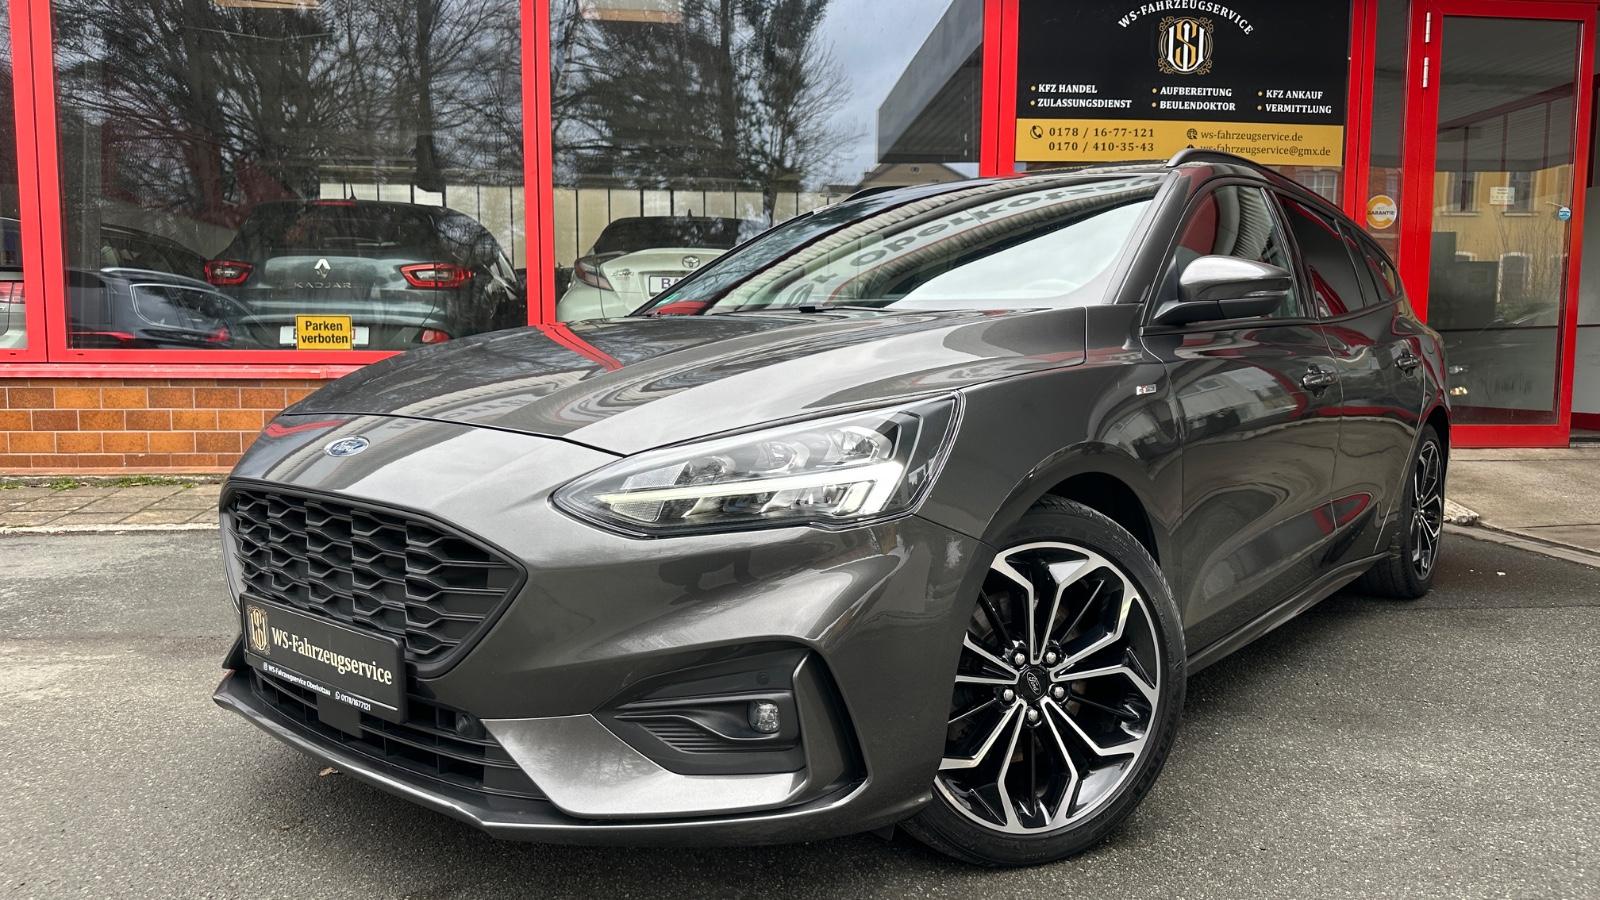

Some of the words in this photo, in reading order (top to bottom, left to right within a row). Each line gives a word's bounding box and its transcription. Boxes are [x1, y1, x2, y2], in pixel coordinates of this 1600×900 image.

[1118, 0, 1254, 35] WS-FAHRZEUGSERVICE
[1038, 84, 1057, 93] KFZ
[1058, 84, 1098, 94] HANDEL
[1160, 86, 1232, 97] AUFBEREITUNG
[1266, 89, 1284, 99] KFZ
[1285, 90, 1324, 100] ANKAUF
[1037, 98, 1132, 108] ZULASSUNGSDIENST
[1159, 100, 1236, 111] BEULENDOKTOR
[1265, 104, 1332, 114] VERMITTLUNG
[1048, 127, 1079, 137] 0178
[1094, 127, 1154, 138] 16-77-121
[1200, 130, 1303, 142] ws-fahrzeugservice.de
[1048, 141, 1079, 151] 0170
[1093, 142, 1154, 152] 410-35-43
[294, 281, 352, 289] KADJAR
[305, 320, 343, 331] Parken
[301, 333, 348, 344] verboten
[271, 626, 393, 685] WS-Fahrzeugservice
